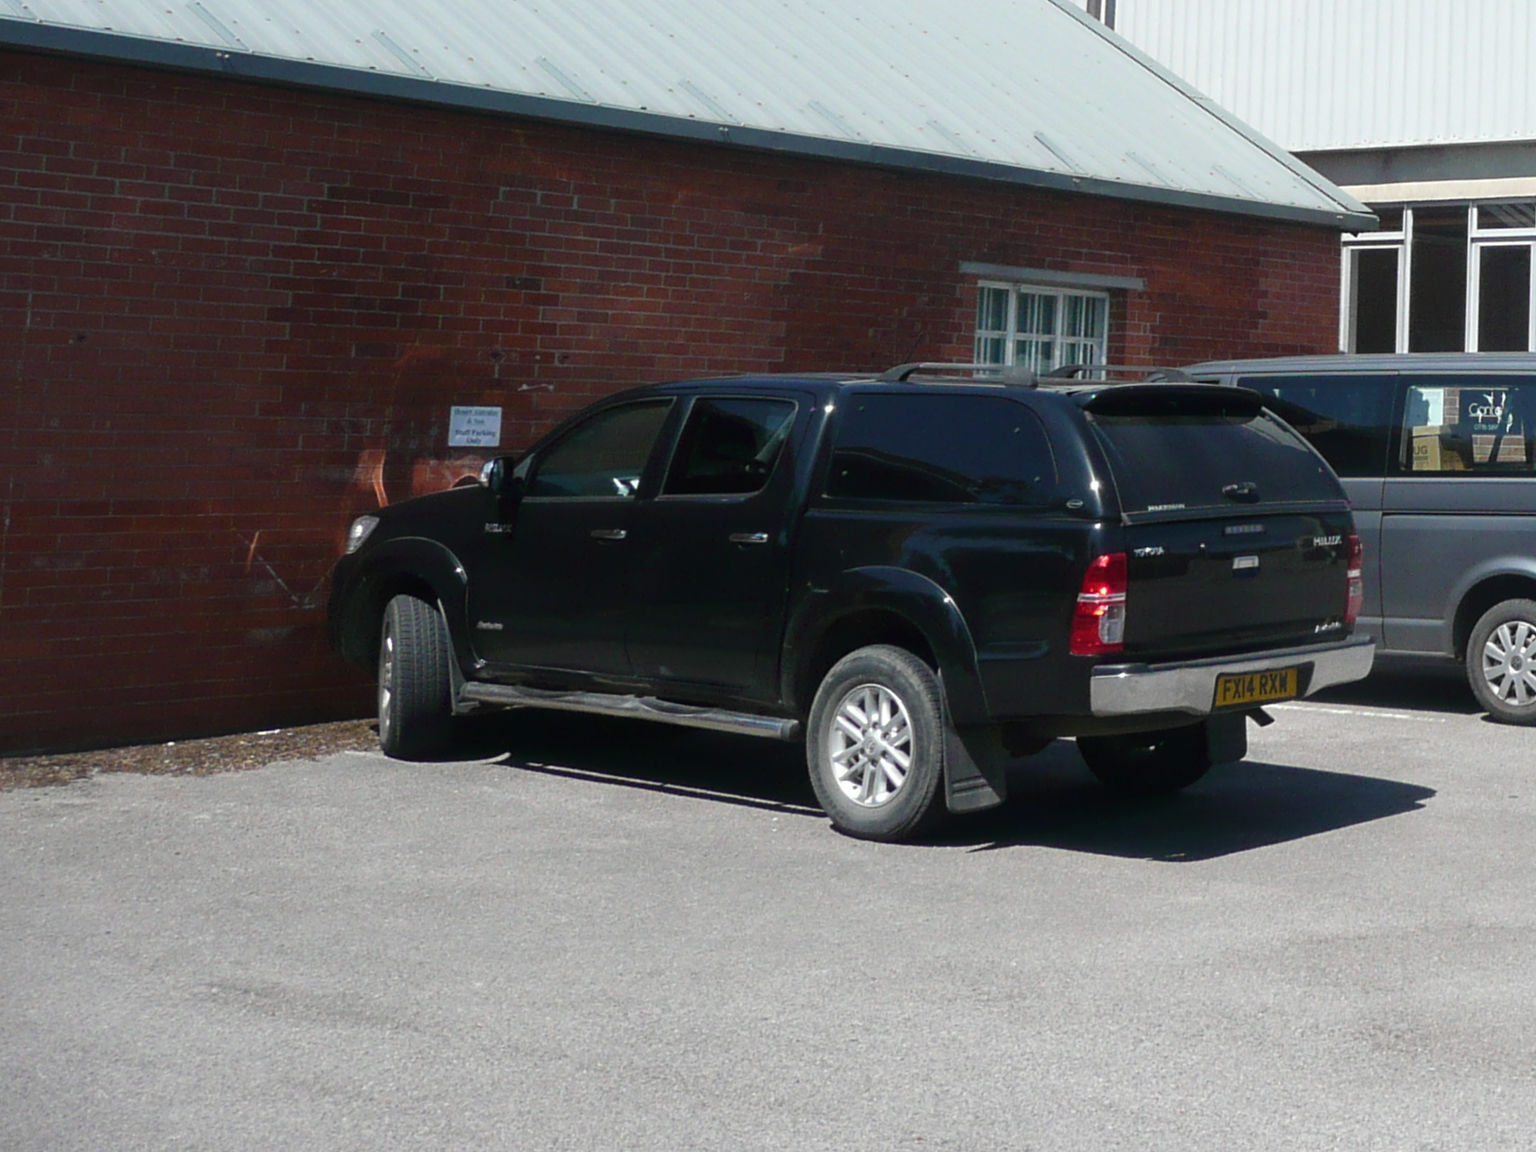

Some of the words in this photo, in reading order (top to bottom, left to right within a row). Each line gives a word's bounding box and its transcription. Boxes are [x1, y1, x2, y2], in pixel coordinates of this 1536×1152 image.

[472, 429, 496, 438] Parking
[1313, 535, 1342, 546] HILUX
[1222, 676, 1255, 702] FX14
